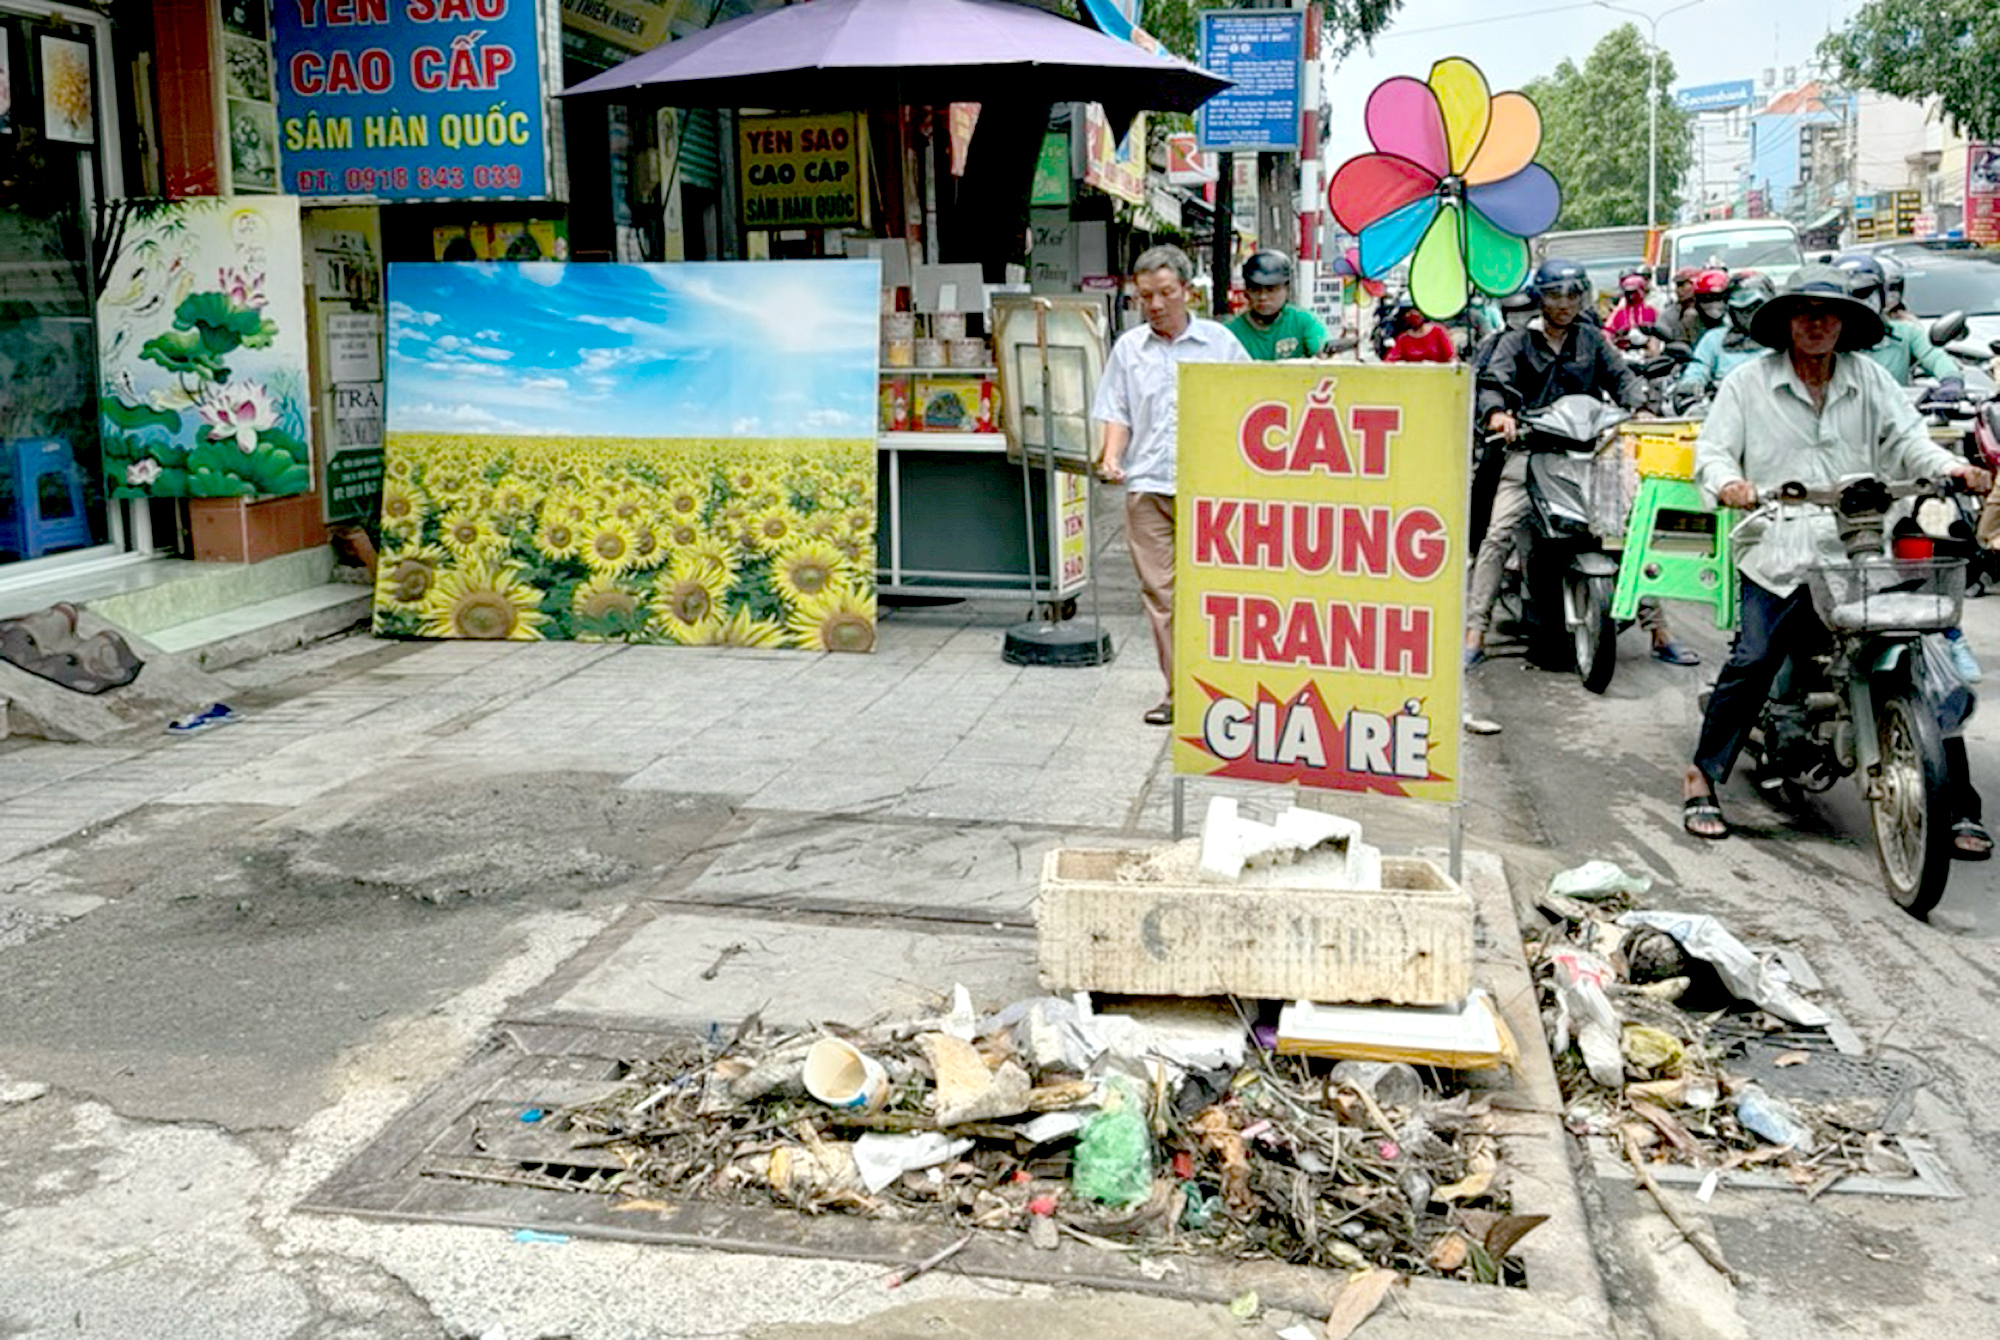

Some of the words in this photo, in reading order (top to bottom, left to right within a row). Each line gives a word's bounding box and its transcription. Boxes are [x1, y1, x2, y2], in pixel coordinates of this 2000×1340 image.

[291, 49, 394, 96] CAO
[411, 30, 515, 92] CẤP
[286, 110, 352, 150] SÂM
[365, 107, 428, 147] HÀN
[441, 101, 529, 149] QUỐC
[801, 127, 849, 152] SAO
[297, 168, 338, 192] ĐT:
[345, 167, 408, 191] 0918
[748, 163, 795, 186] CAO
[336, 383, 378, 407] TRÀ
[1237, 377, 1402, 478] CẮT
[1193, 497, 1448, 579] KHUNG
[1201, 592, 1433, 679] TRANH
[1205, 692, 1327, 769] GIÁ
[1346, 697, 1431, 778] RẺ
